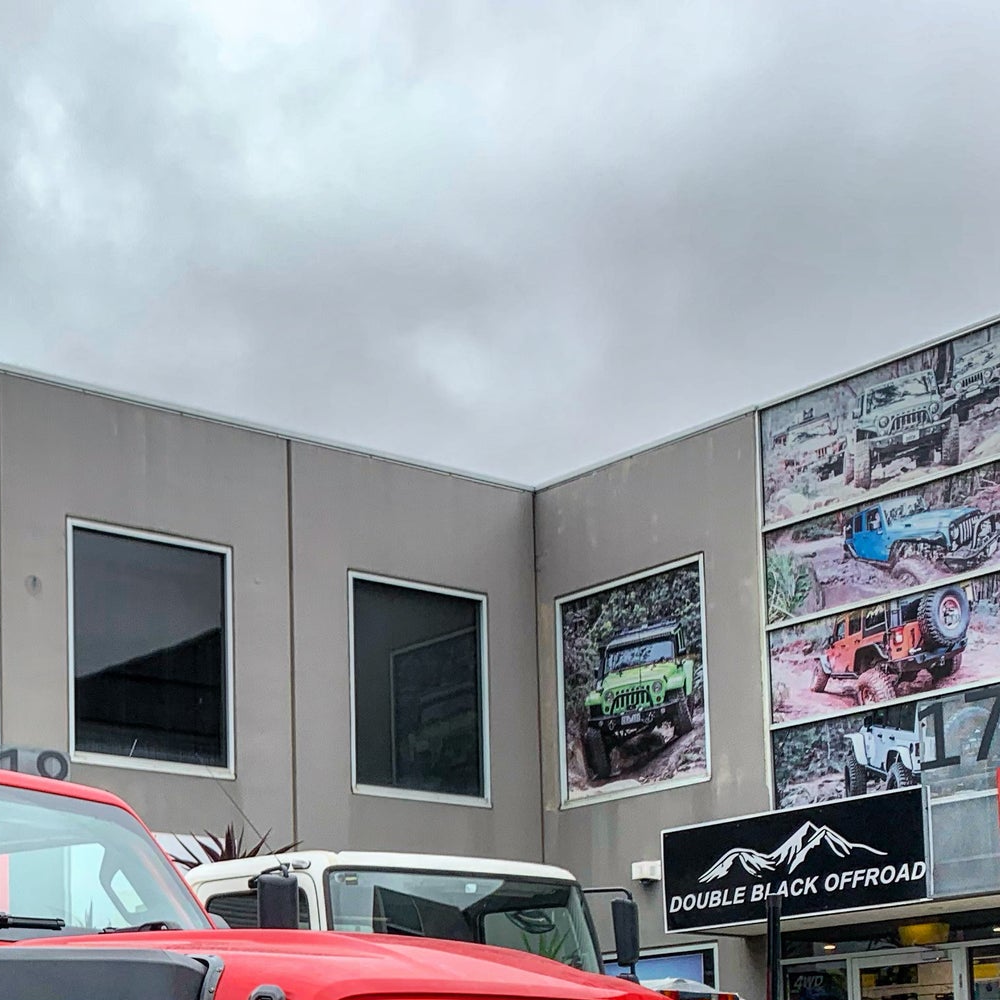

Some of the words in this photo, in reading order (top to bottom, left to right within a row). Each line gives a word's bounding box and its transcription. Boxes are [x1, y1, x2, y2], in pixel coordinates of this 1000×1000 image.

[918, 686, 1000, 771] 17
[669, 886, 746, 913] DOUBLE
[750, 875, 820, 902] BLACK
[824, 861, 927, 892] OFFROAD
